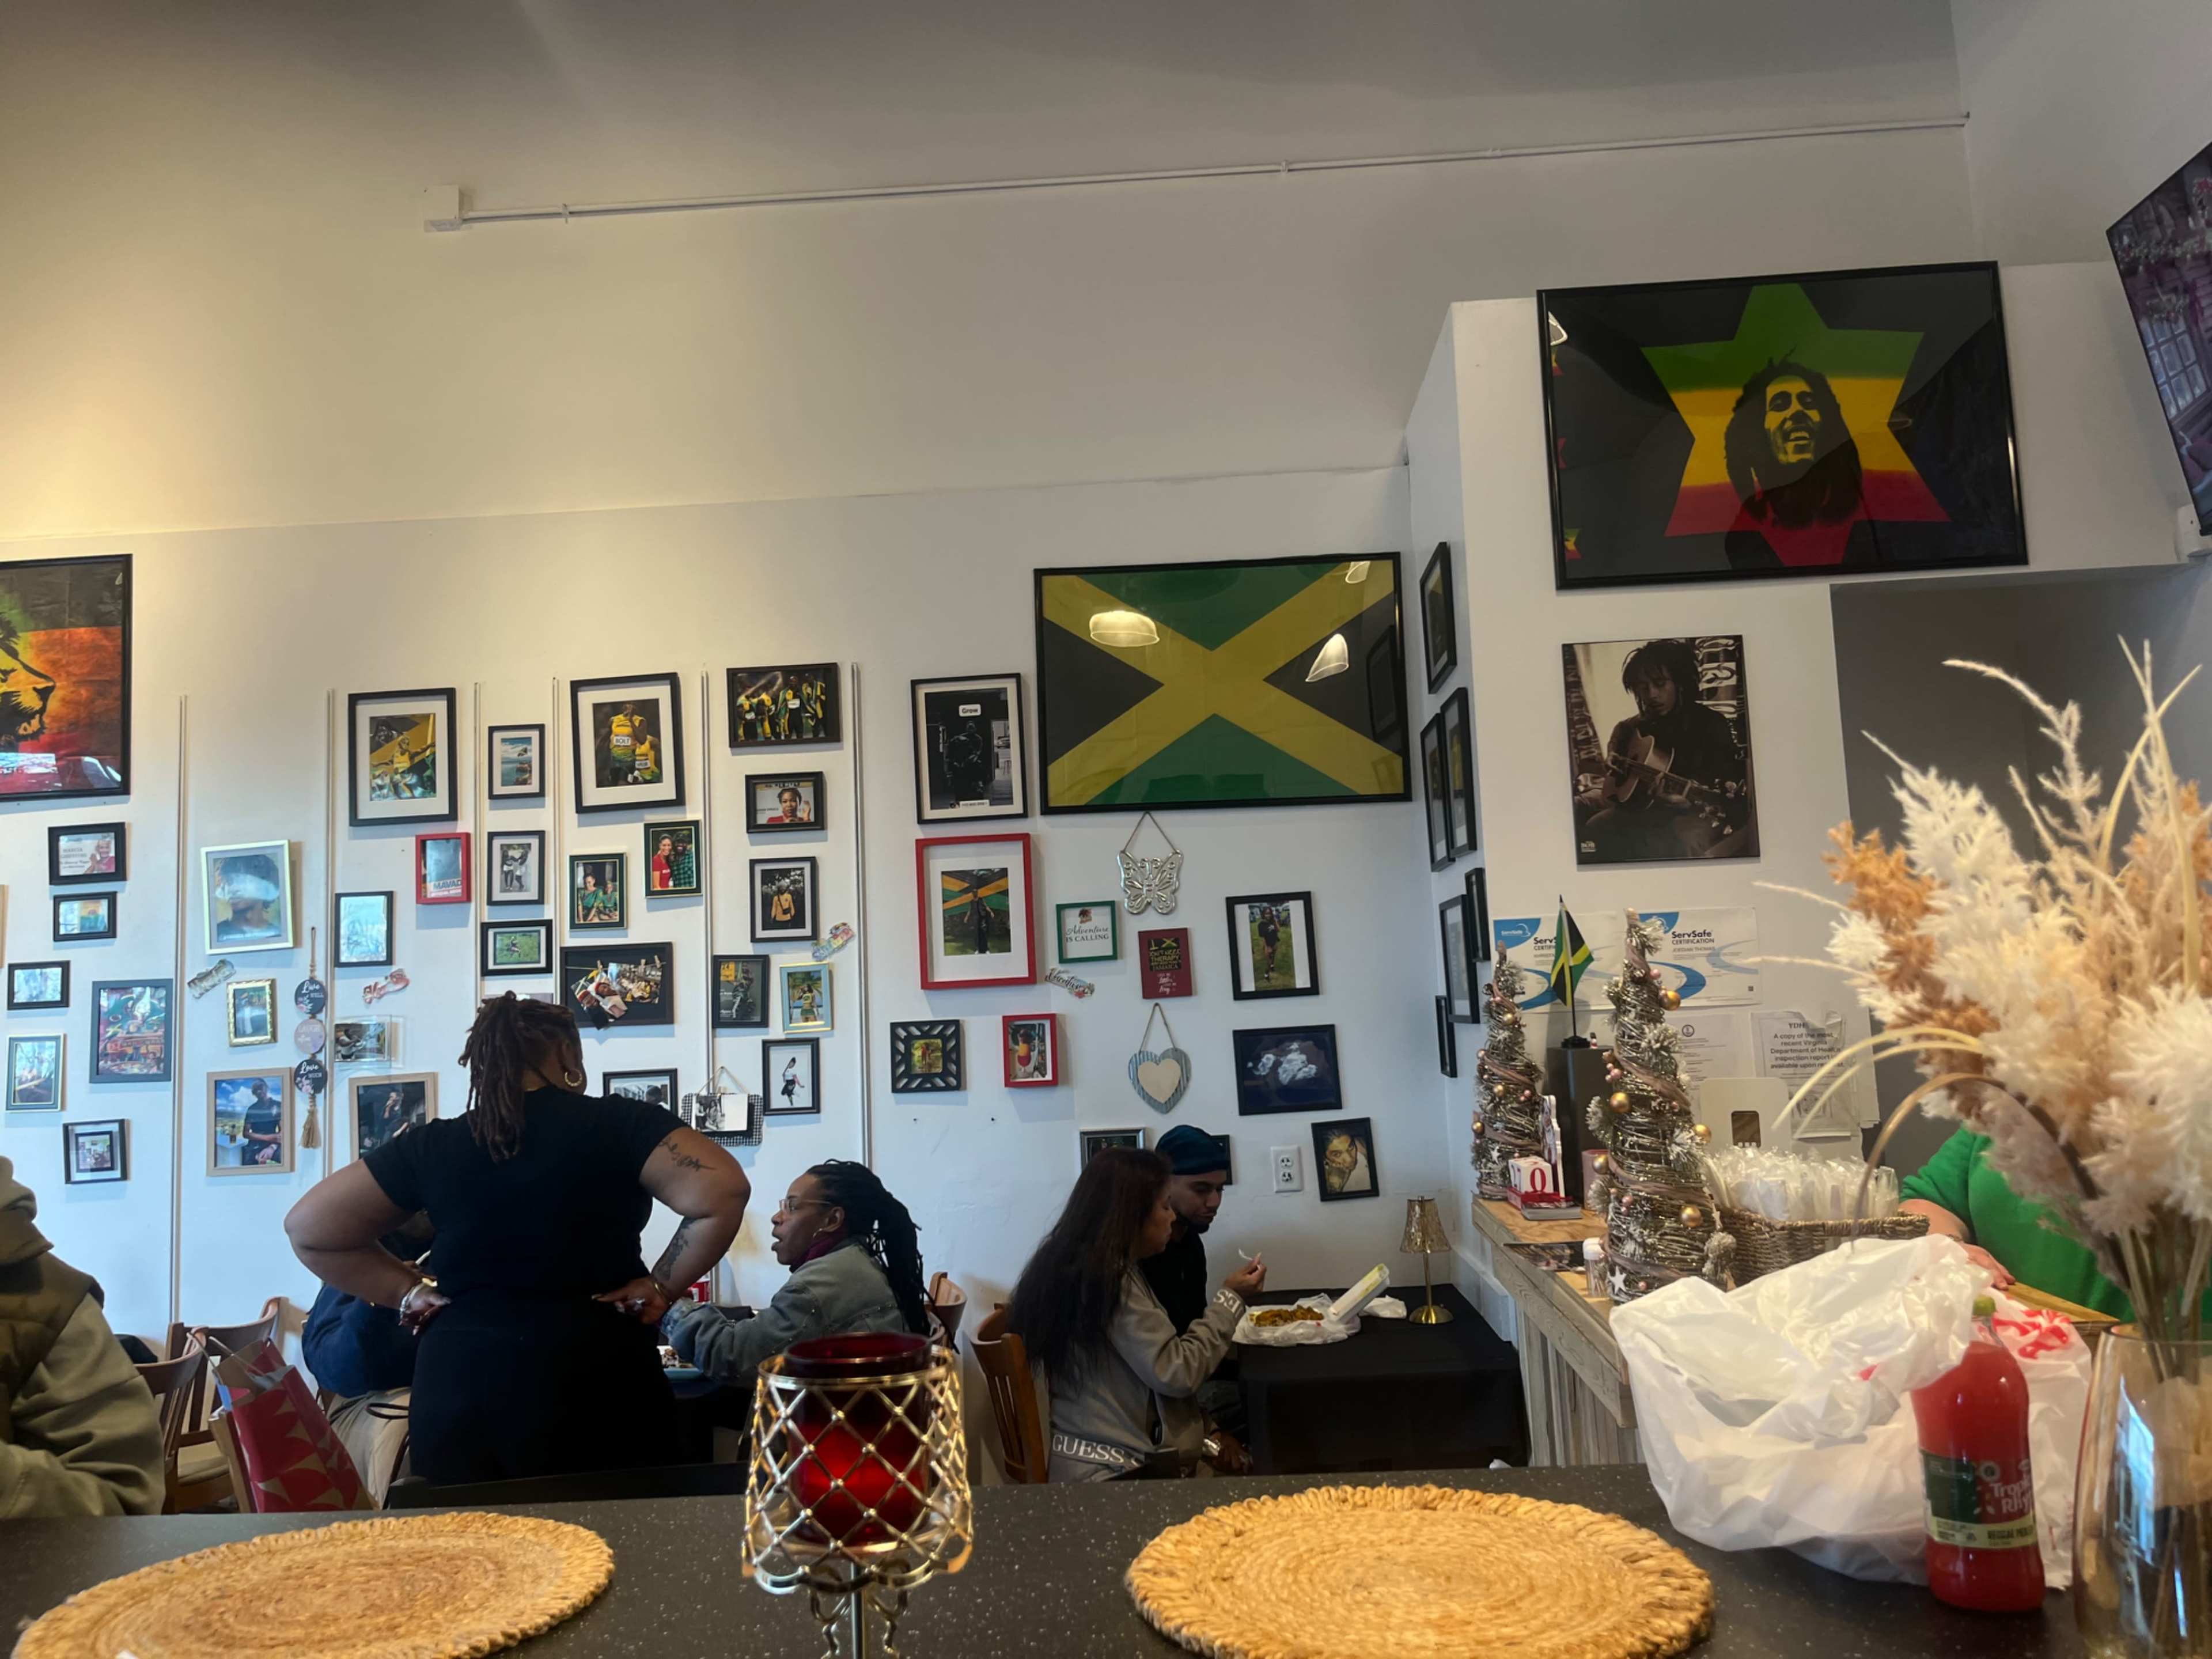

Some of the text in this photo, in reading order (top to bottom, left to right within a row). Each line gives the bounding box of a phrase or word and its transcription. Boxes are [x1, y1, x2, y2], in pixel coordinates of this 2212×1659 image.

[1075, 933, 1109, 942] CALLING
[1672, 929, 1712, 939] ServSafe
[1530, 1168, 1546, 1192] 0
[1052, 1434, 1124, 1464] GUESS
